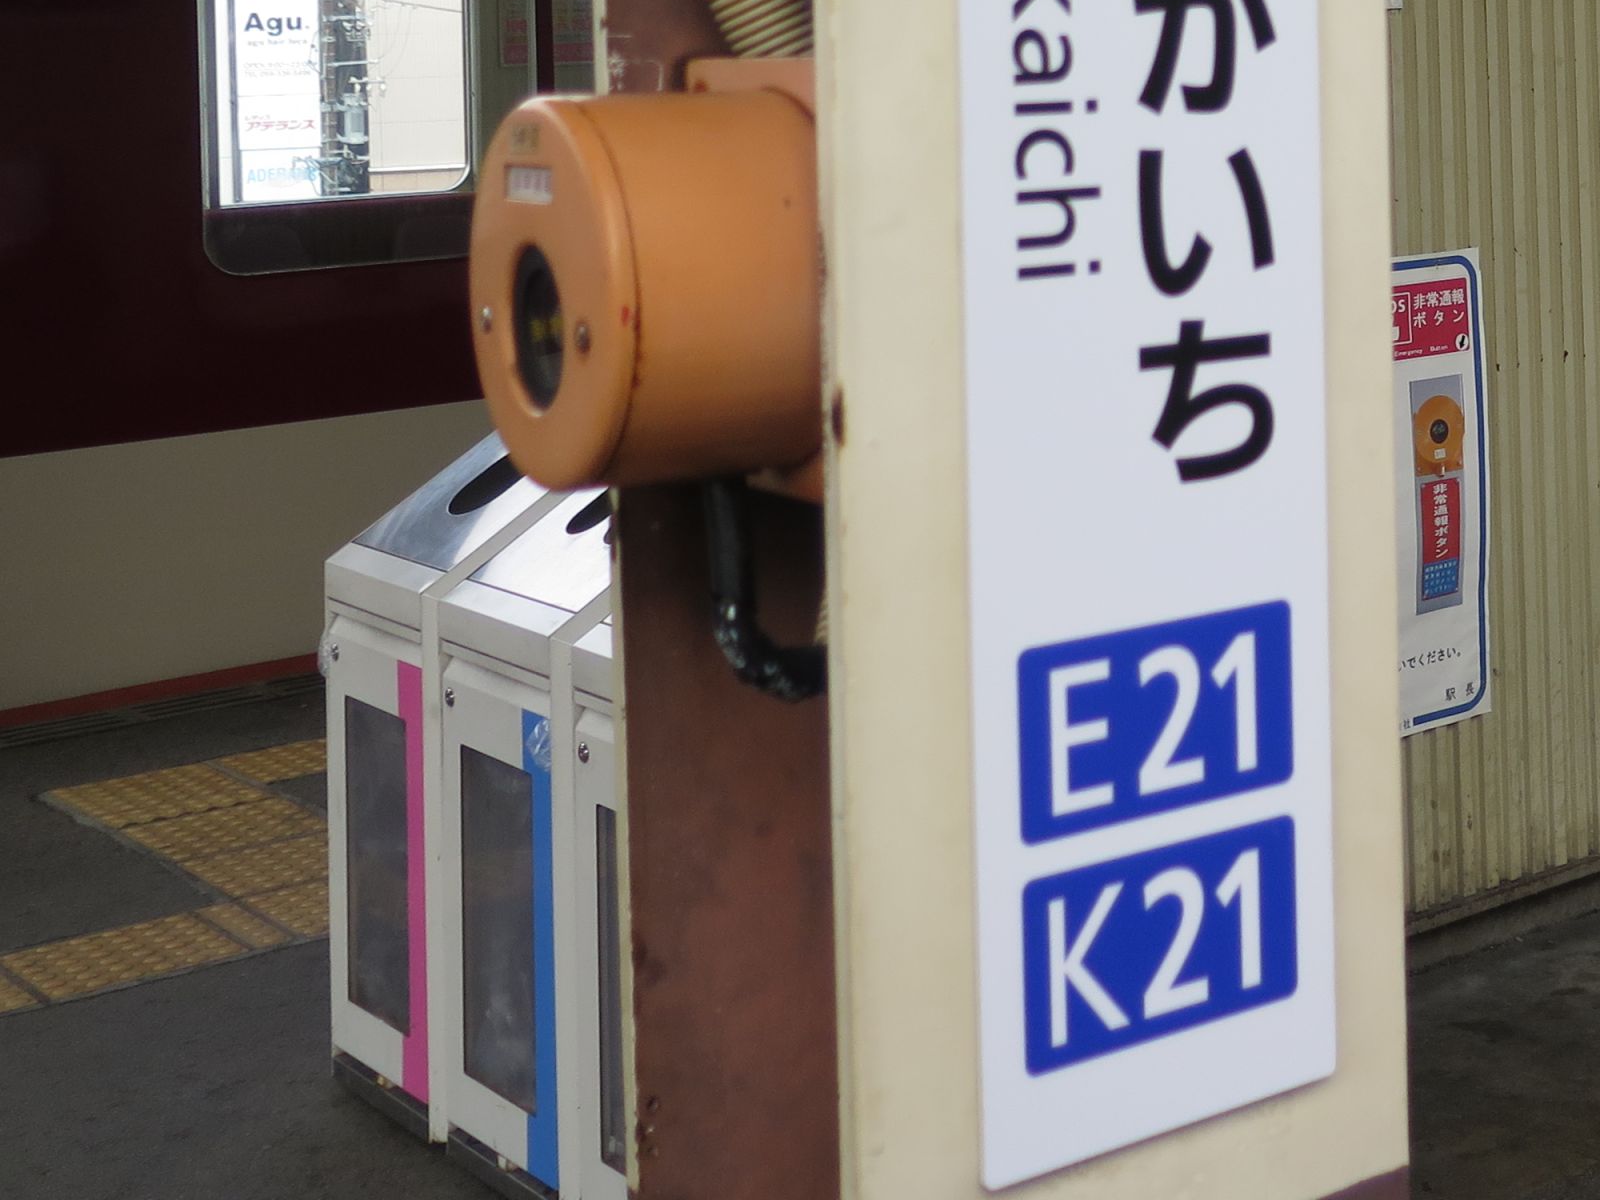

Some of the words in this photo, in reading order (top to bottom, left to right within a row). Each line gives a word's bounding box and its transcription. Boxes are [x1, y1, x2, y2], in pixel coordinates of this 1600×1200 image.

[1413, 288, 1465, 310] 非常通報
[1432, 482, 1449, 559] 非常通報ボタン
[1049, 629, 1258, 820] E21
[1048, 847, 1263, 1050] K21
